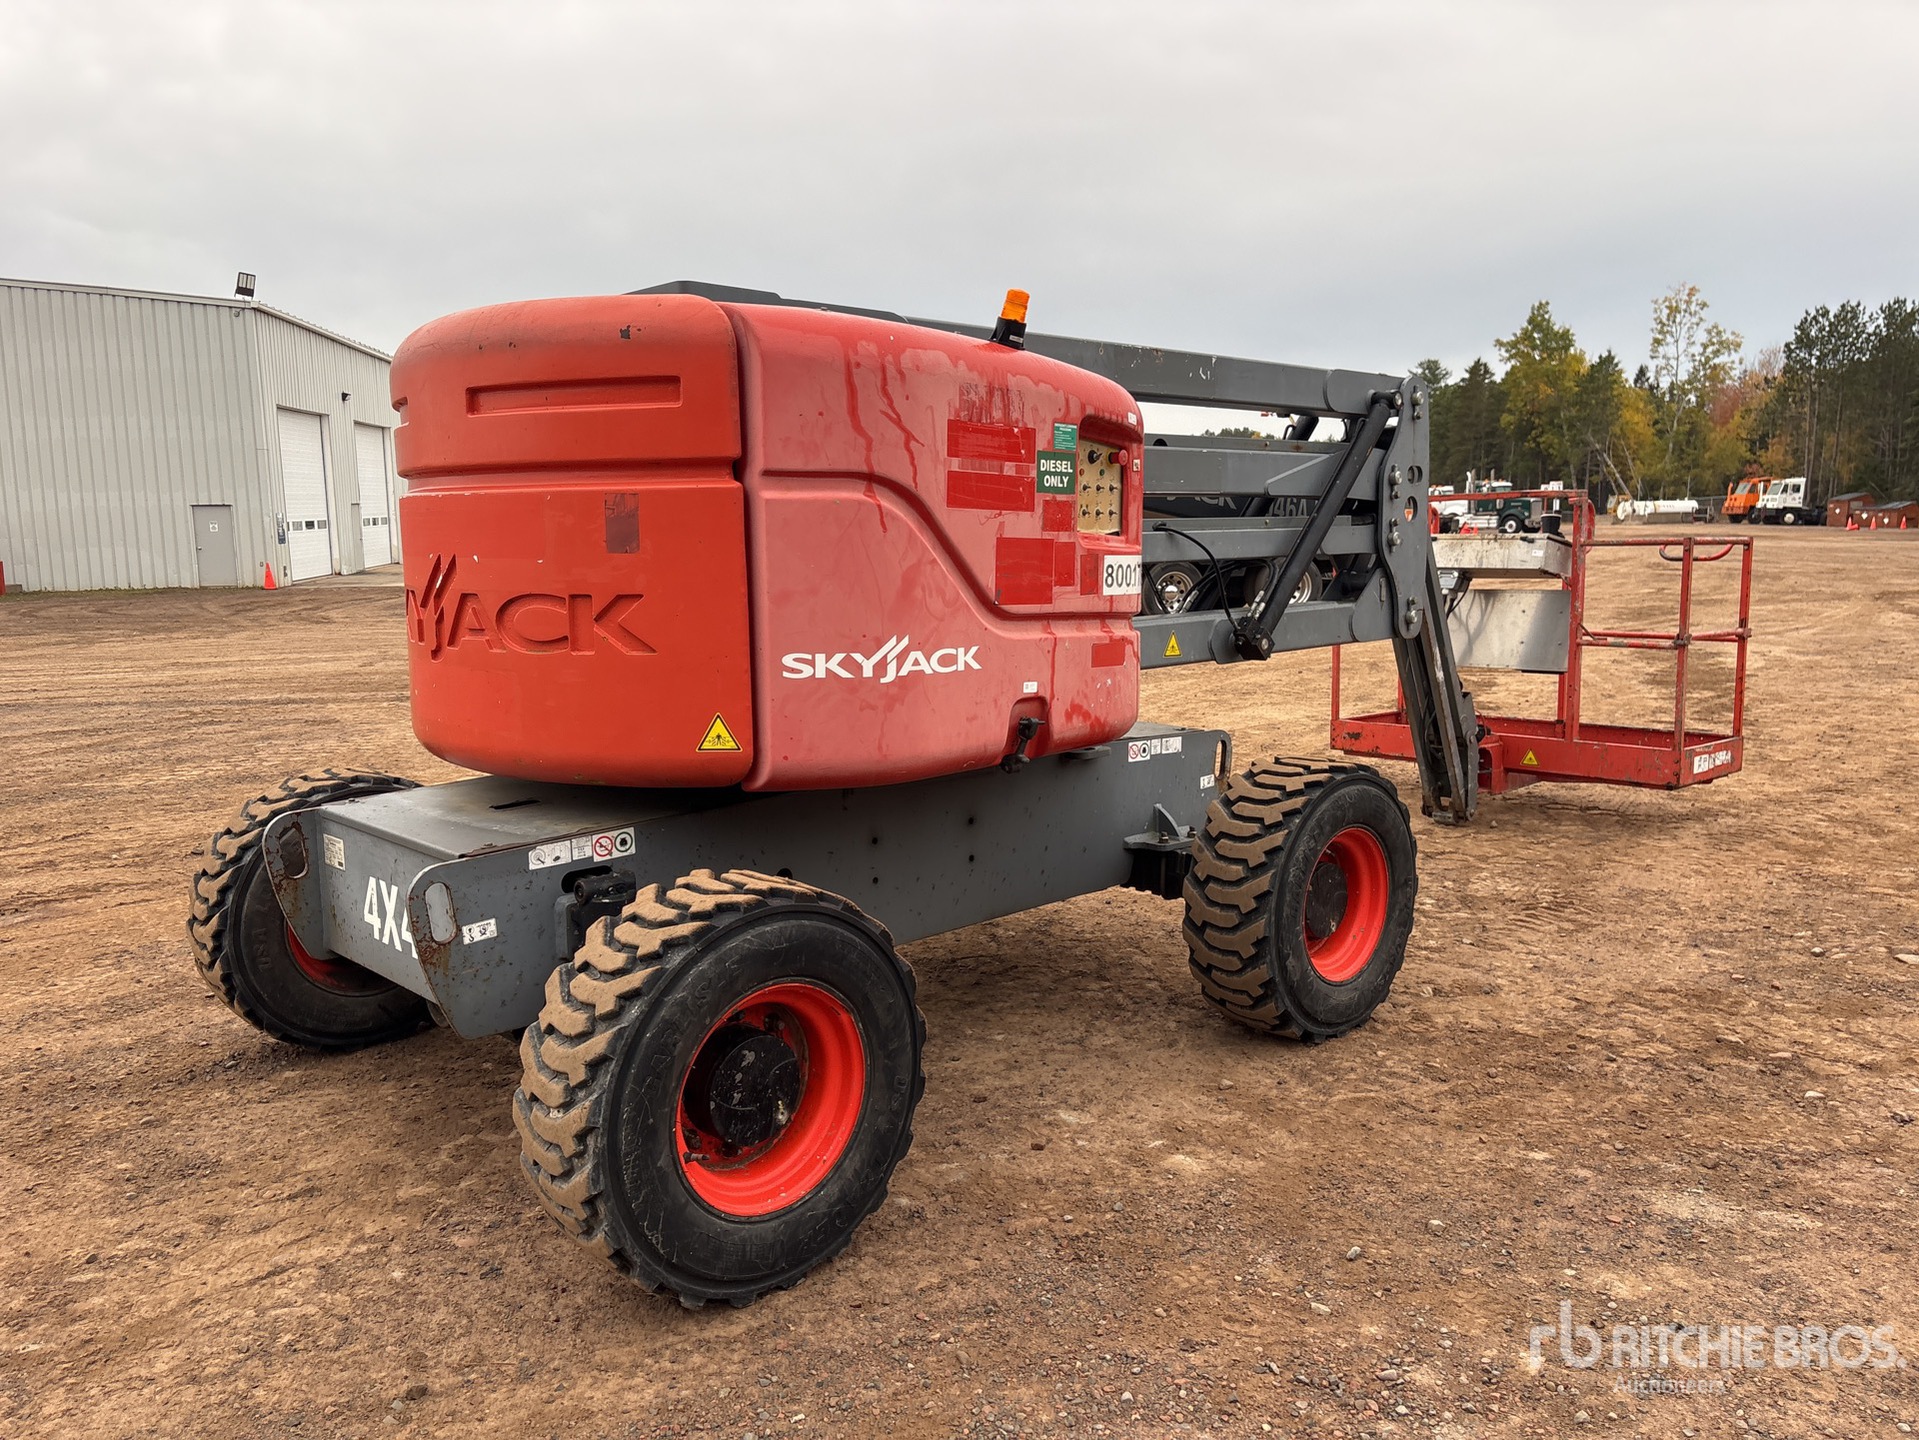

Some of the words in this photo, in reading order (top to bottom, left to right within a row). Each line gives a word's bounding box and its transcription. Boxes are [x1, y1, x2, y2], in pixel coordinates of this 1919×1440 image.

[1040, 459, 1073, 473] DIESEL
[1044, 475, 1069, 488] ONLY
[405, 553, 659, 664] YJACK
[781, 634, 982, 684] SKYJACK
